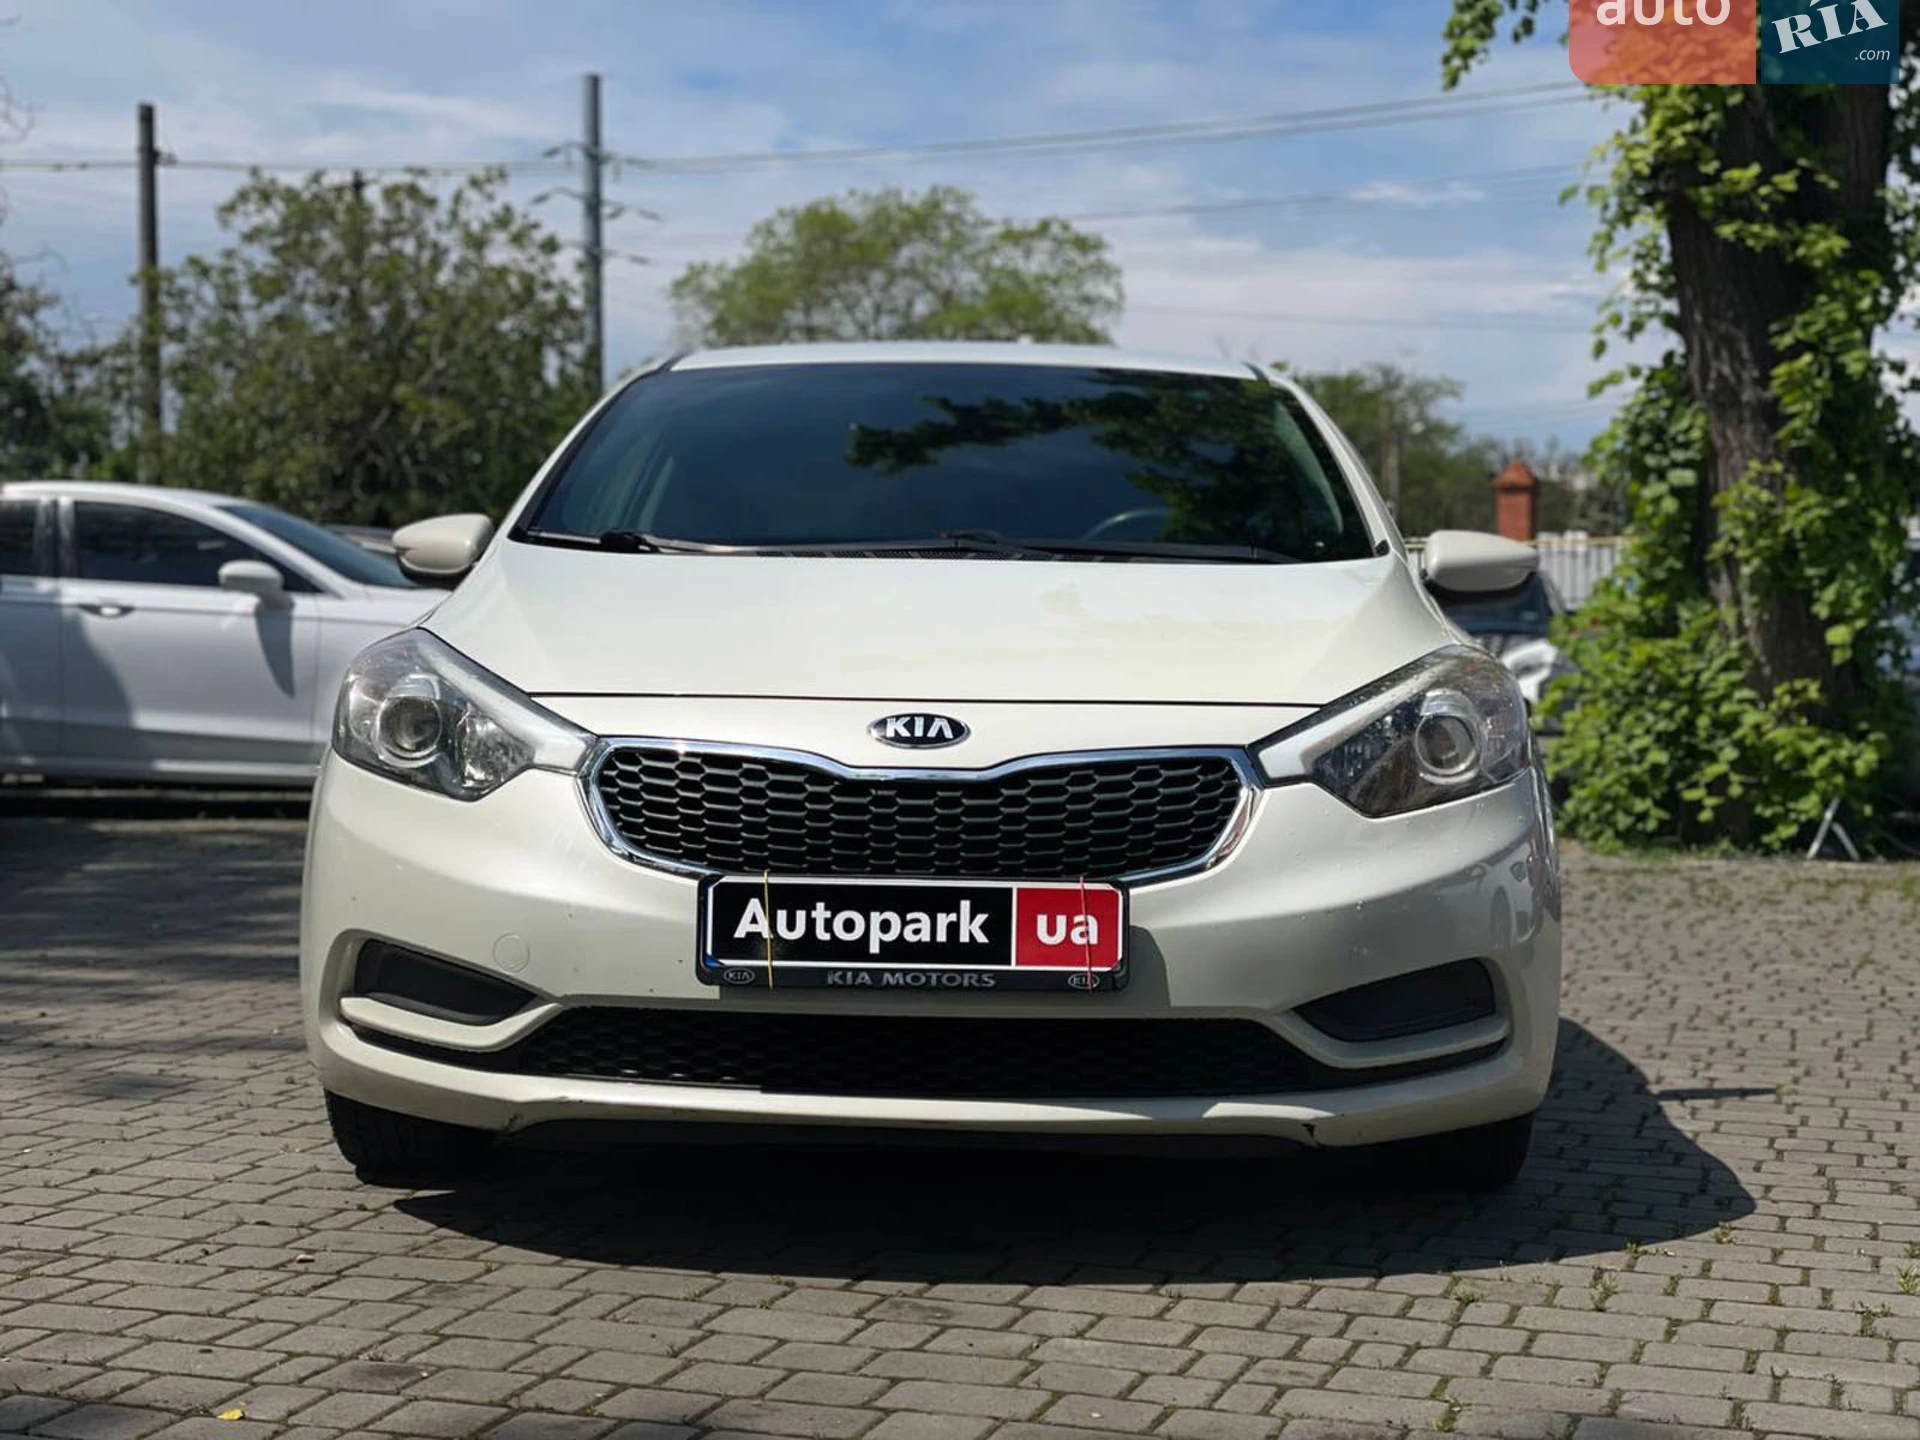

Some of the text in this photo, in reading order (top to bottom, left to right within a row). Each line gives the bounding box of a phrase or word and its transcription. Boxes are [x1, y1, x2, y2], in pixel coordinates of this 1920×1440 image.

[886, 716, 954, 739] KIA
[733, 898, 1099, 954] Autopark ua
[827, 970, 996, 988] KIA MOTORS
